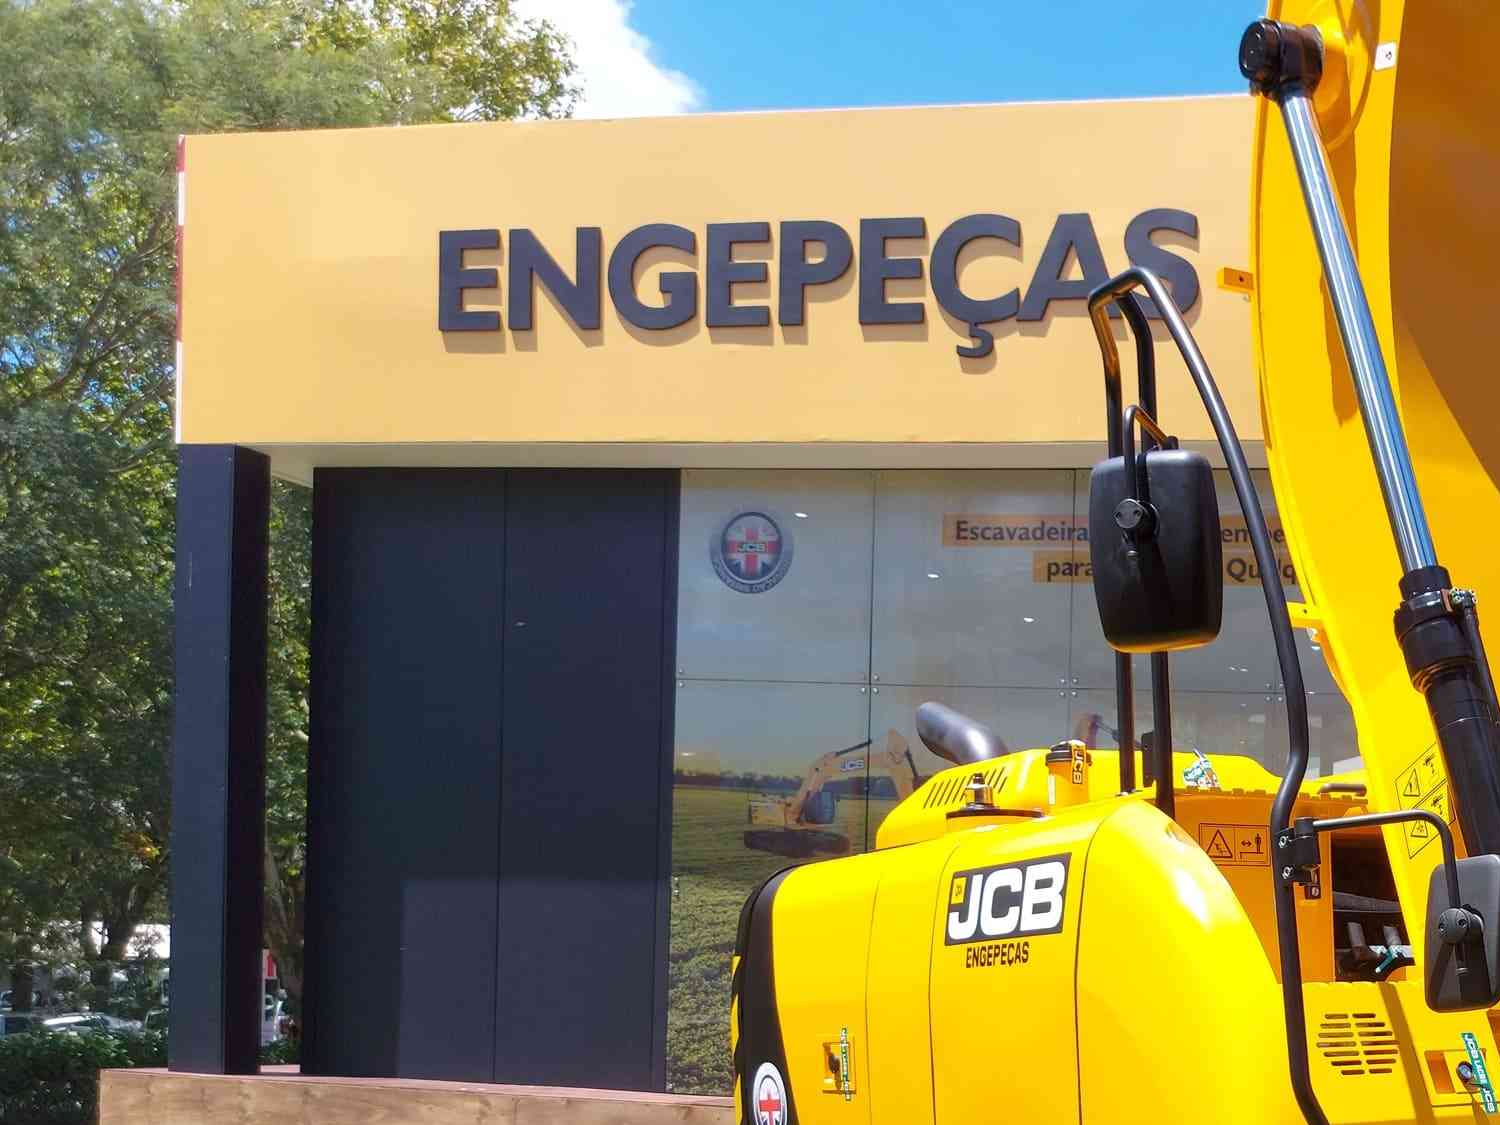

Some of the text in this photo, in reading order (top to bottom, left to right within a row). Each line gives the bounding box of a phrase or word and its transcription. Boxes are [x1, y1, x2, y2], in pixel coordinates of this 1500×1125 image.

[438, 207, 1200, 359] ENGEPEÇAS
[948, 861, 1066, 940] JCB
[965, 941, 1030, 969] ENGEPEÇAS
